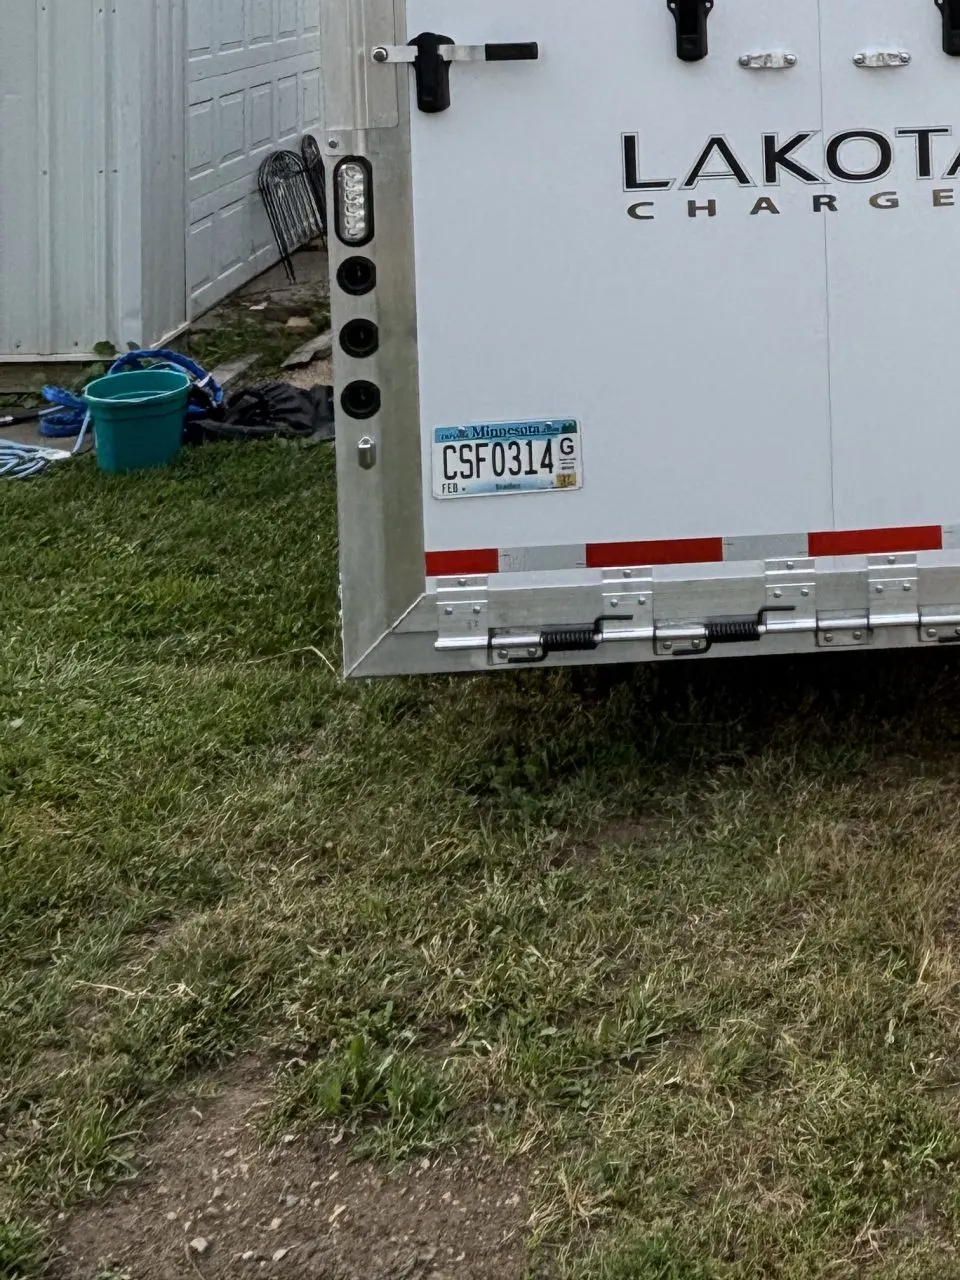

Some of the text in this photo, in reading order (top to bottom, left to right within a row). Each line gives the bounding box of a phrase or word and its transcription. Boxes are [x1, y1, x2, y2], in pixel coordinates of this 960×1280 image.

[472, 424, 540, 438] Minnesota
[560, 437, 574, 455] G
[442, 438, 554, 480] CSF0314
[441, 482, 458, 494] FEB
